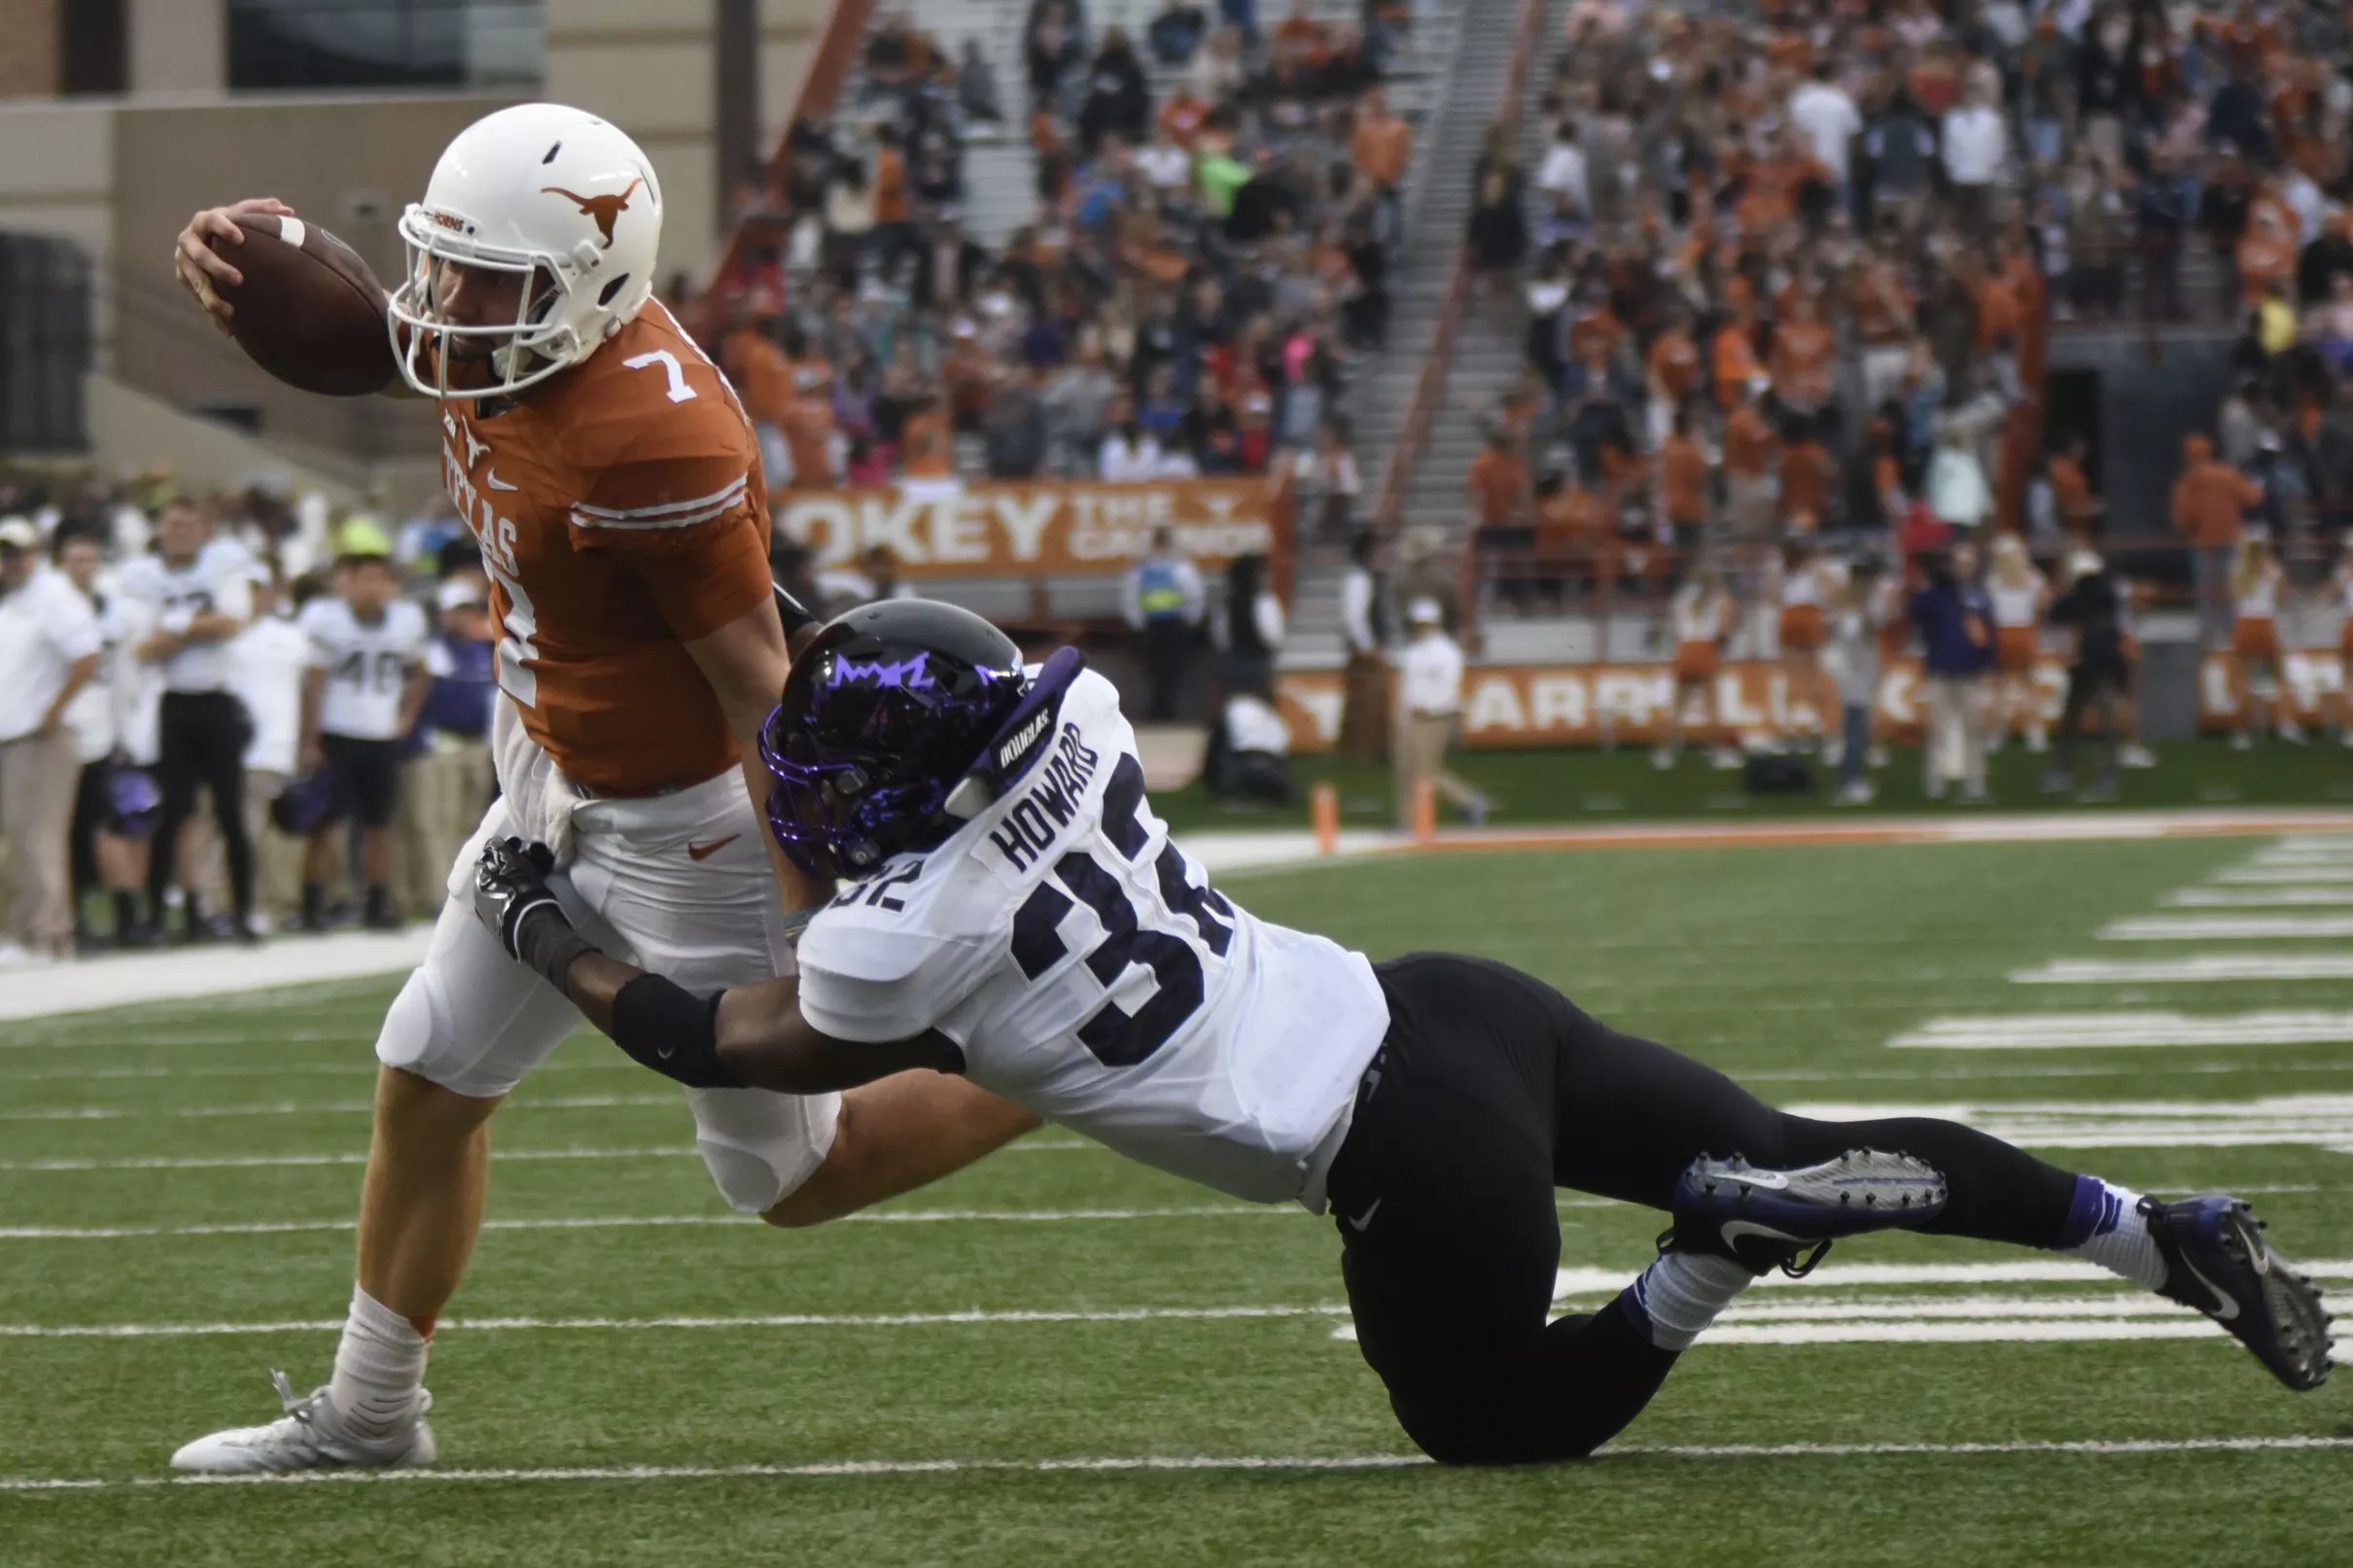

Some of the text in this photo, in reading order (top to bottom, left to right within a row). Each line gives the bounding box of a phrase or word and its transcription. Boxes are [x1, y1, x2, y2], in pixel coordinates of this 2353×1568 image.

[622, 349, 698, 403] 7
[1000, 708, 1050, 769] DOUGLAS
[990, 721, 1100, 873] HOWARD
[1008, 750, 1237, 1067] 32
